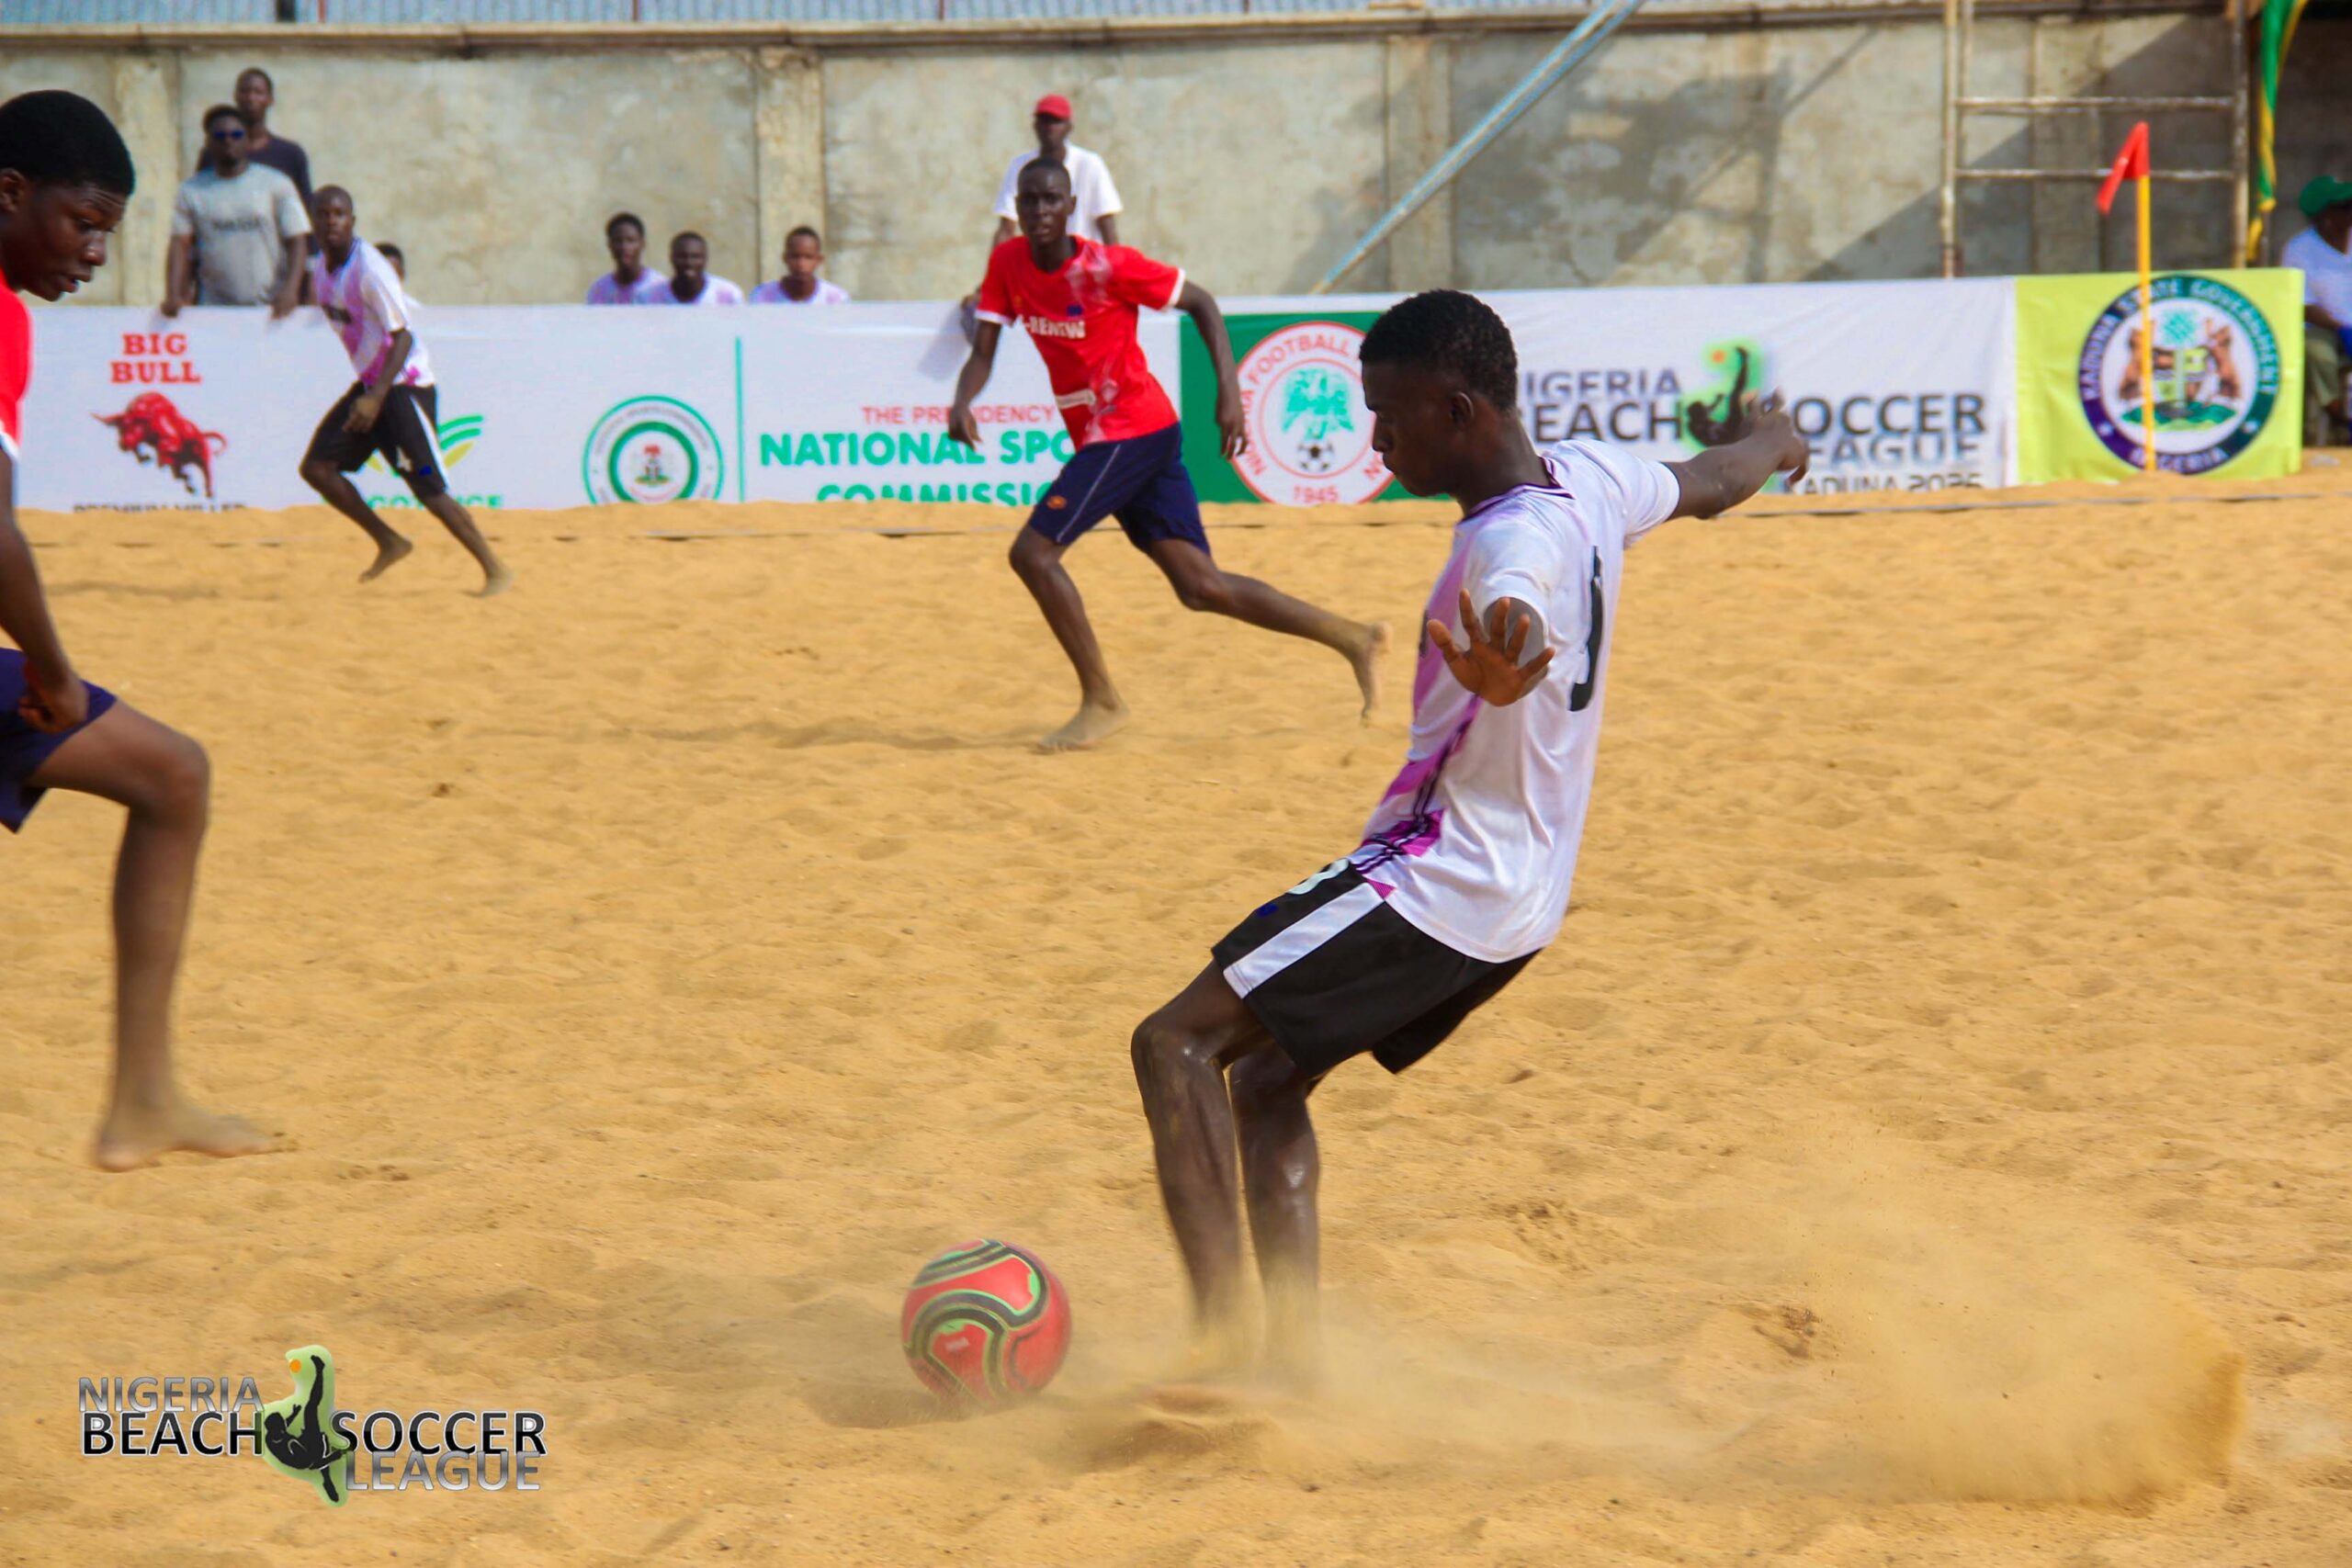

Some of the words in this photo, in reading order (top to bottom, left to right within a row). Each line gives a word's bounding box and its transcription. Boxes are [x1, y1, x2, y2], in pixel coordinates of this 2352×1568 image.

[2118, 279, 2178, 314] STTE
[121, 332, 188, 355] BIG
[110, 360, 202, 384] BULL
[1248, 333, 1351, 386] FOOTBALL
[1527, 368, 1680, 397] IGERIA
[862, 406, 904, 423] THE
[1535, 401, 1682, 443] EACH
[1793, 393, 1986, 435] OCCER
[759, 432, 986, 466] NATIONAL
[1000, 430, 1075, 465] SPO
[1808, 435, 1979, 465] EAGUE
[2130, 446, 2231, 470] NGERIA
[817, 482, 1054, 506] COMMISSI
[1294, 485, 1339, 503] 1945
